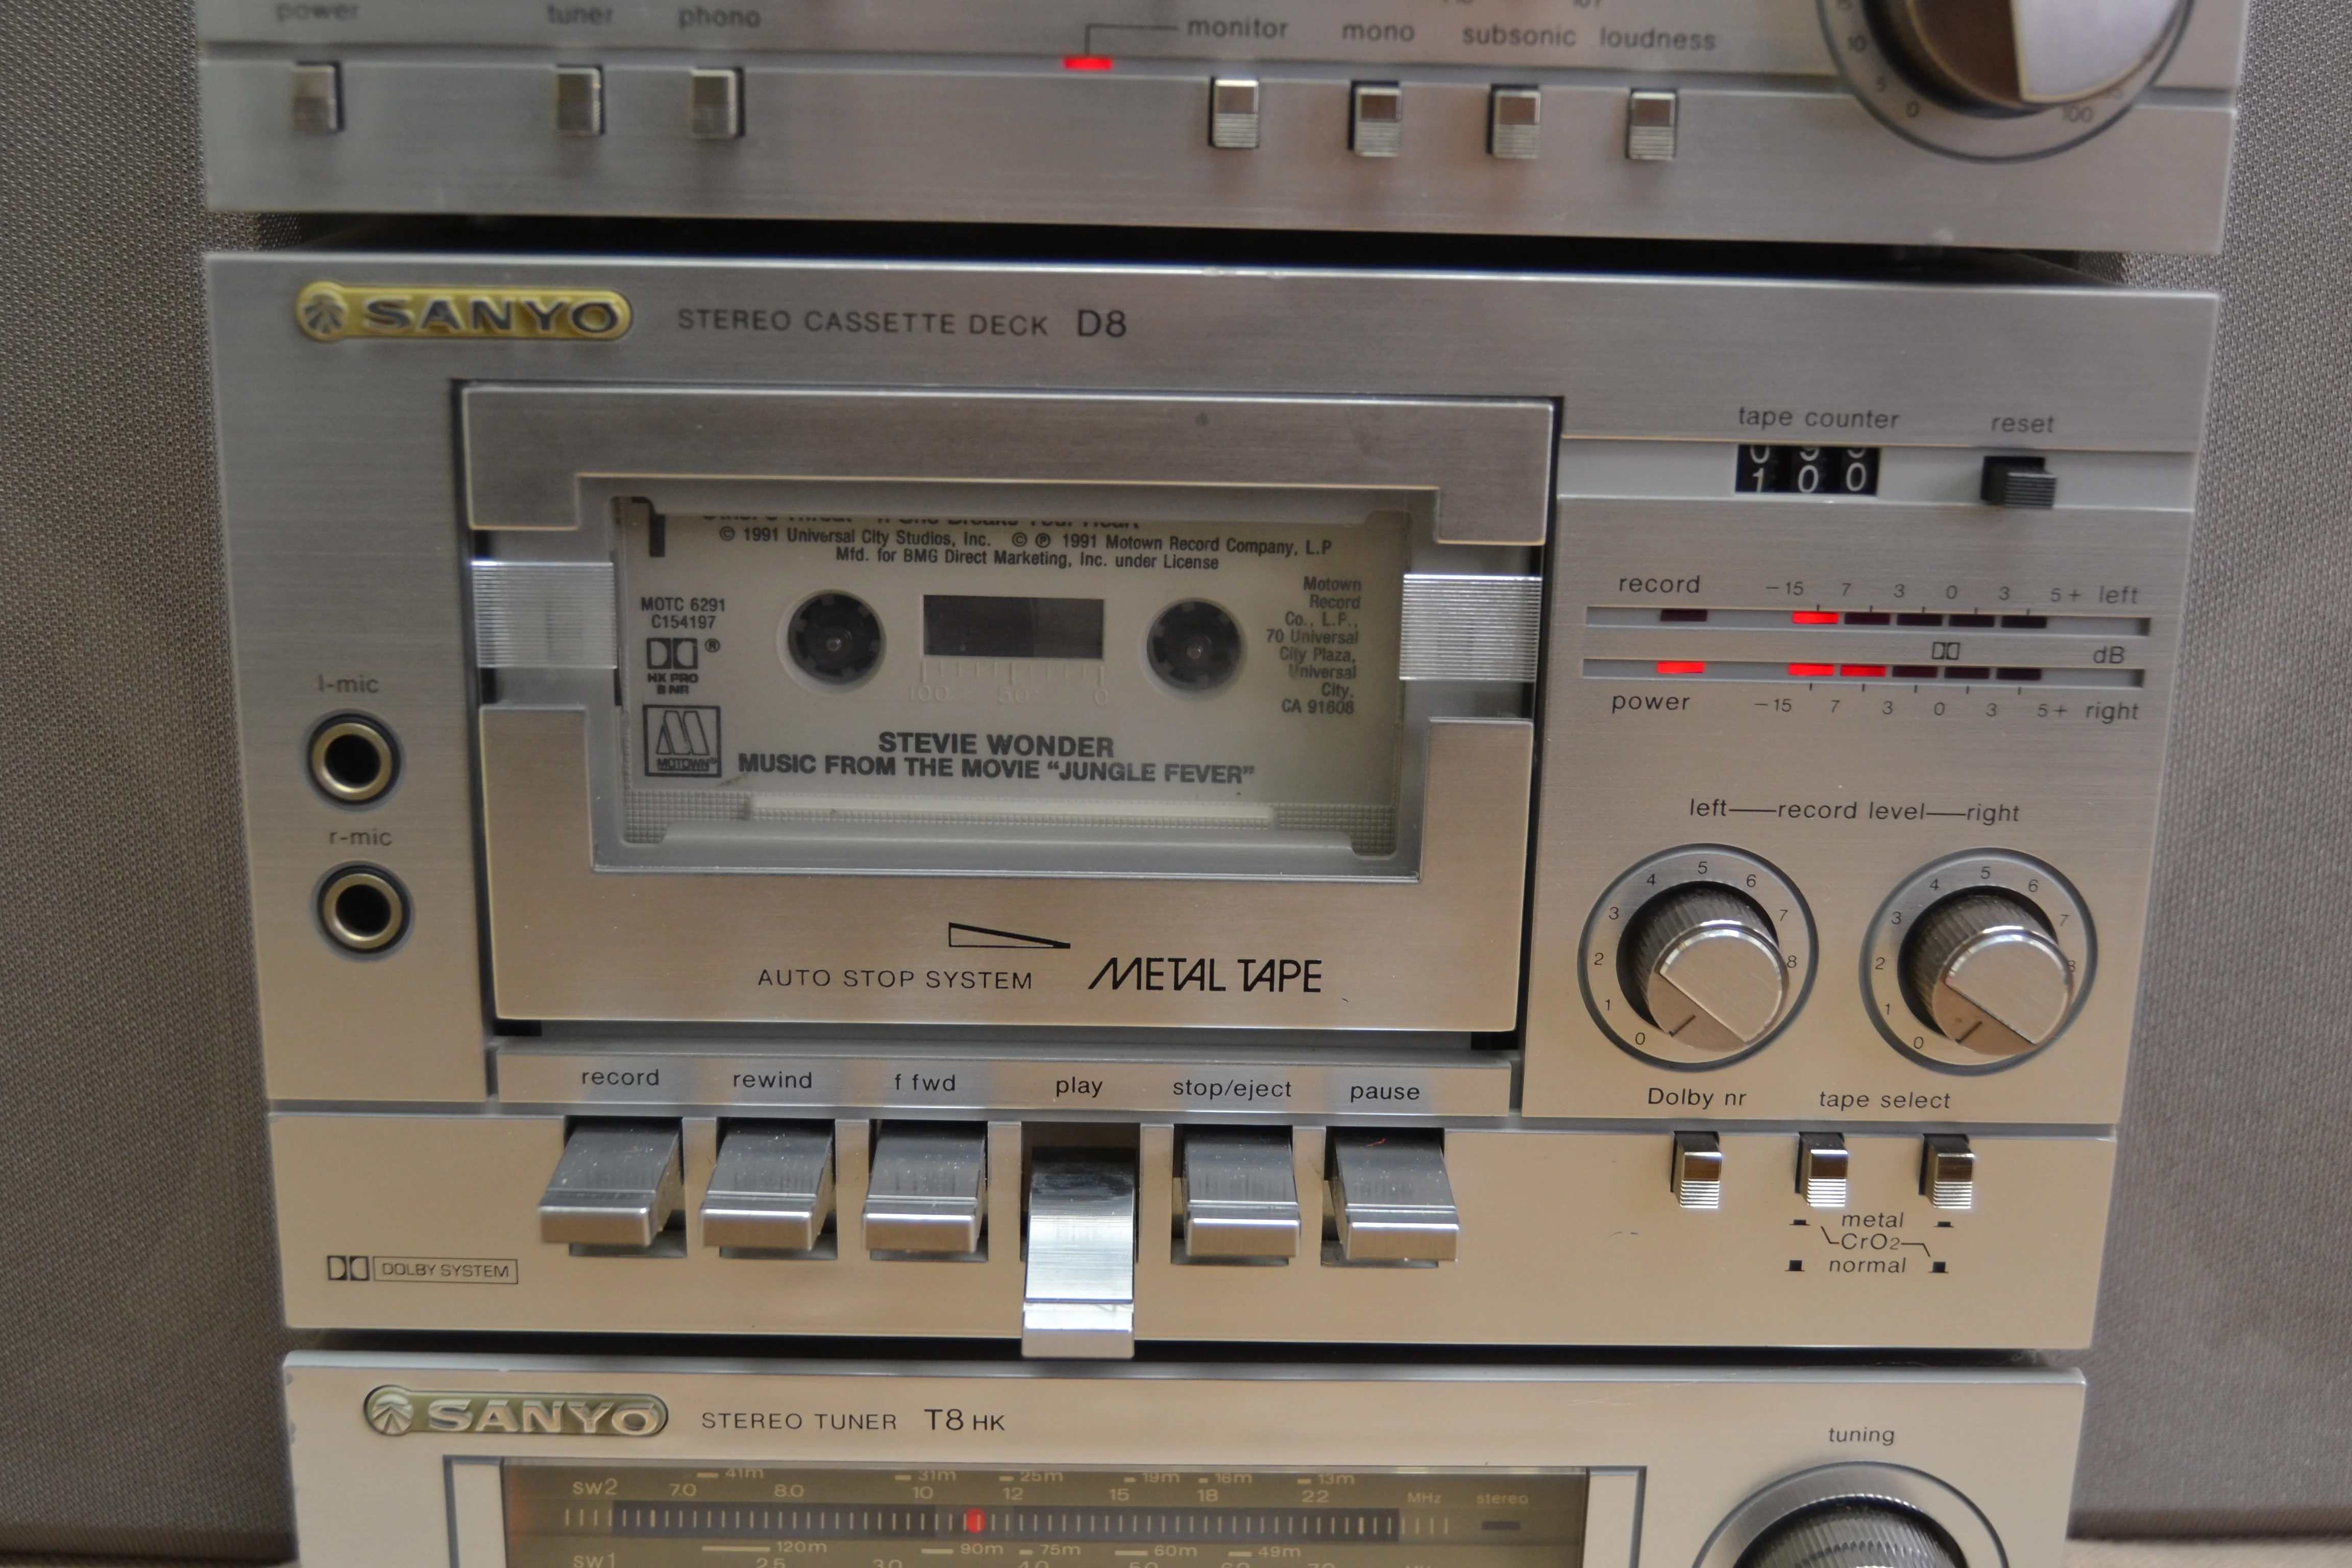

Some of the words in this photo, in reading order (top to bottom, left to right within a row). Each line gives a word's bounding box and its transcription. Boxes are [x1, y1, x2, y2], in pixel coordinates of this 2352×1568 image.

[548, 5, 615, 26] tuner
[678, 5, 763, 29] phono
[1187, 15, 1288, 41] monitor
[1342, 21, 1416, 43] mono
[1462, 24, 1577, 47] subsonic
[1600, 26, 1717, 51] loudness
[360, 293, 621, 335] SANYO
[677, 308, 792, 332] STEREO
[803, 309, 956, 335] CASSETTE
[968, 312, 1049, 337] DECK
[1075, 308, 1128, 339] D8
[1737, 406, 1794, 432] tape
[1804, 407, 1900, 430] counter
[1990, 412, 2056, 434] reset
[743, 527, 779, 542] 1991
[787, 527, 855, 544] Universal
[861, 529, 890, 548] City
[895, 529, 956, 547] Studios,
[963, 532, 991, 547] Inc.
[1062, 533, 1097, 549] 1991
[1105, 534, 1163, 551] Motown
[1169, 536, 1220, 552] Record
[1226, 537, 1298, 558] Company,
[836, 546, 870, 561] Mfd.
[877, 547, 897, 562] for
[903, 548, 938, 564] BMG
[944, 548, 988, 566] Direct
[993, 550, 1072, 570] Marketing,
[1080, 551, 1108, 568] Inc.
[1115, 553, 1157, 569] under
[1163, 553, 1219, 570] License
[1303, 576, 1362, 592] Motown
[1618, 575, 1702, 594] record
[1841, 582, 1852, 596] 7
[1893, 583, 1905, 598] 3
[1946, 585, 1958, 599] 0
[1998, 586, 2010, 600] 3
[2098, 585, 2139, 604] left
[641, 596, 684, 611] MOTC
[690, 597, 725, 612] 6291
[1309, 593, 1361, 609] Record
[651, 614, 716, 630] C154197
[1266, 628, 1285, 643] 70
[1290, 629, 1359, 645] Universal
[1280, 645, 1307, 664] City
[1312, 646, 1356, 664] Plaza,
[2093, 645, 2125, 665] dB
[670, 673, 699, 684] PRO
[1288, 663, 1357, 680] Universal
[1281, 698, 1302, 714] CA
[1307, 699, 1355, 715] 91608
[1612, 694, 1690, 714] power
[1829, 699, 1841, 714] 7
[1882, 701, 1894, 716] 3
[1933, 702, 1946, 716] 0
[1986, 703, 1998, 717] 3
[2085, 701, 2140, 724] right
[878, 731, 977, 755] STEVIE
[986, 733, 1115, 758] WONDER
[738, 752, 817, 774] MUSIC
[824, 754, 896, 777] FROM
[904, 756, 953, 778] THE
[961, 757, 1040, 780] MOVIE
[1689, 797, 1726, 817] left
[1778, 801, 1857, 819] record
[1868, 800, 1924, 820] level
[1967, 802, 2020, 827] right
[1697, 861, 1708, 875] 5
[1980, 866, 1991, 880] 5
[1646, 873, 1656, 886] 4
[1746, 874, 1757, 888] 6
[1929, 878, 1940, 891] 4
[2028, 879, 2039, 893] 6
[1608, 906, 1620, 921] 3
[1778, 909, 1790, 922] 7
[1891, 912, 1902, 925] 3
[2060, 914, 2069, 927] 7
[1594, 952, 1604, 966] 2
[1786, 954, 1797, 969] 8
[1875, 957, 1886, 970] 2
[757, 968, 831, 987] AUTO
[842, 969, 915, 988] STOP
[925, 970, 1032, 990] SYSTEM
[1087, 957, 1227, 992] METAL
[1237, 959, 1323, 993] TAPE
[1605, 998, 1611, 1011] 1
[1884, 1002, 1891, 1016] 1
[1634, 1031, 1646, 1045] 0
[1913, 1035, 1924, 1049] 0
[581, 1068, 660, 1087] record
[732, 1070, 813, 1089] rewind
[1055, 1075, 1104, 1097] play
[1172, 1078, 1292, 1099] stop/eject
[1350, 1082, 1421, 1102] pause
[1647, 1087, 1714, 1110] Dolby
[1724, 1091, 1748, 1107] nr
[1819, 1090, 1870, 1112] tape
[1879, 1091, 1951, 1110] select
[1841, 1212, 1905, 1229] metal
[382, 1262, 437, 1277] DOLBY
[440, 1263, 510, 1279] SYSTEM
[1828, 1258, 1907, 1274] normal
[428, 1399, 660, 1436] SANYO
[702, 1412, 803, 1430] STEREO
[814, 1413, 897, 1431] TUNER
[923, 1408, 965, 1431] T8
[972, 1414, 1006, 1431] HK
[1828, 1427, 1896, 1447] tuning
[912, 1485, 934, 1500] 10
[1003, 1486, 1024, 1501] 12
[1110, 1487, 1130, 1502] 15
[1197, 1488, 1219, 1503] 18
[1302, 1489, 1329, 1504] 22
[1407, 1491, 1442, 1505] MHz
[1476, 1492, 1529, 1505] stereo
[776, 1540, 827, 1554] 120m
[960, 1542, 1003, 1556] 90m
[1039, 1544, 1082, 1557] 75m
[1154, 1545, 1198, 1558] 60m
[1258, 1546, 1302, 1559] 49m
